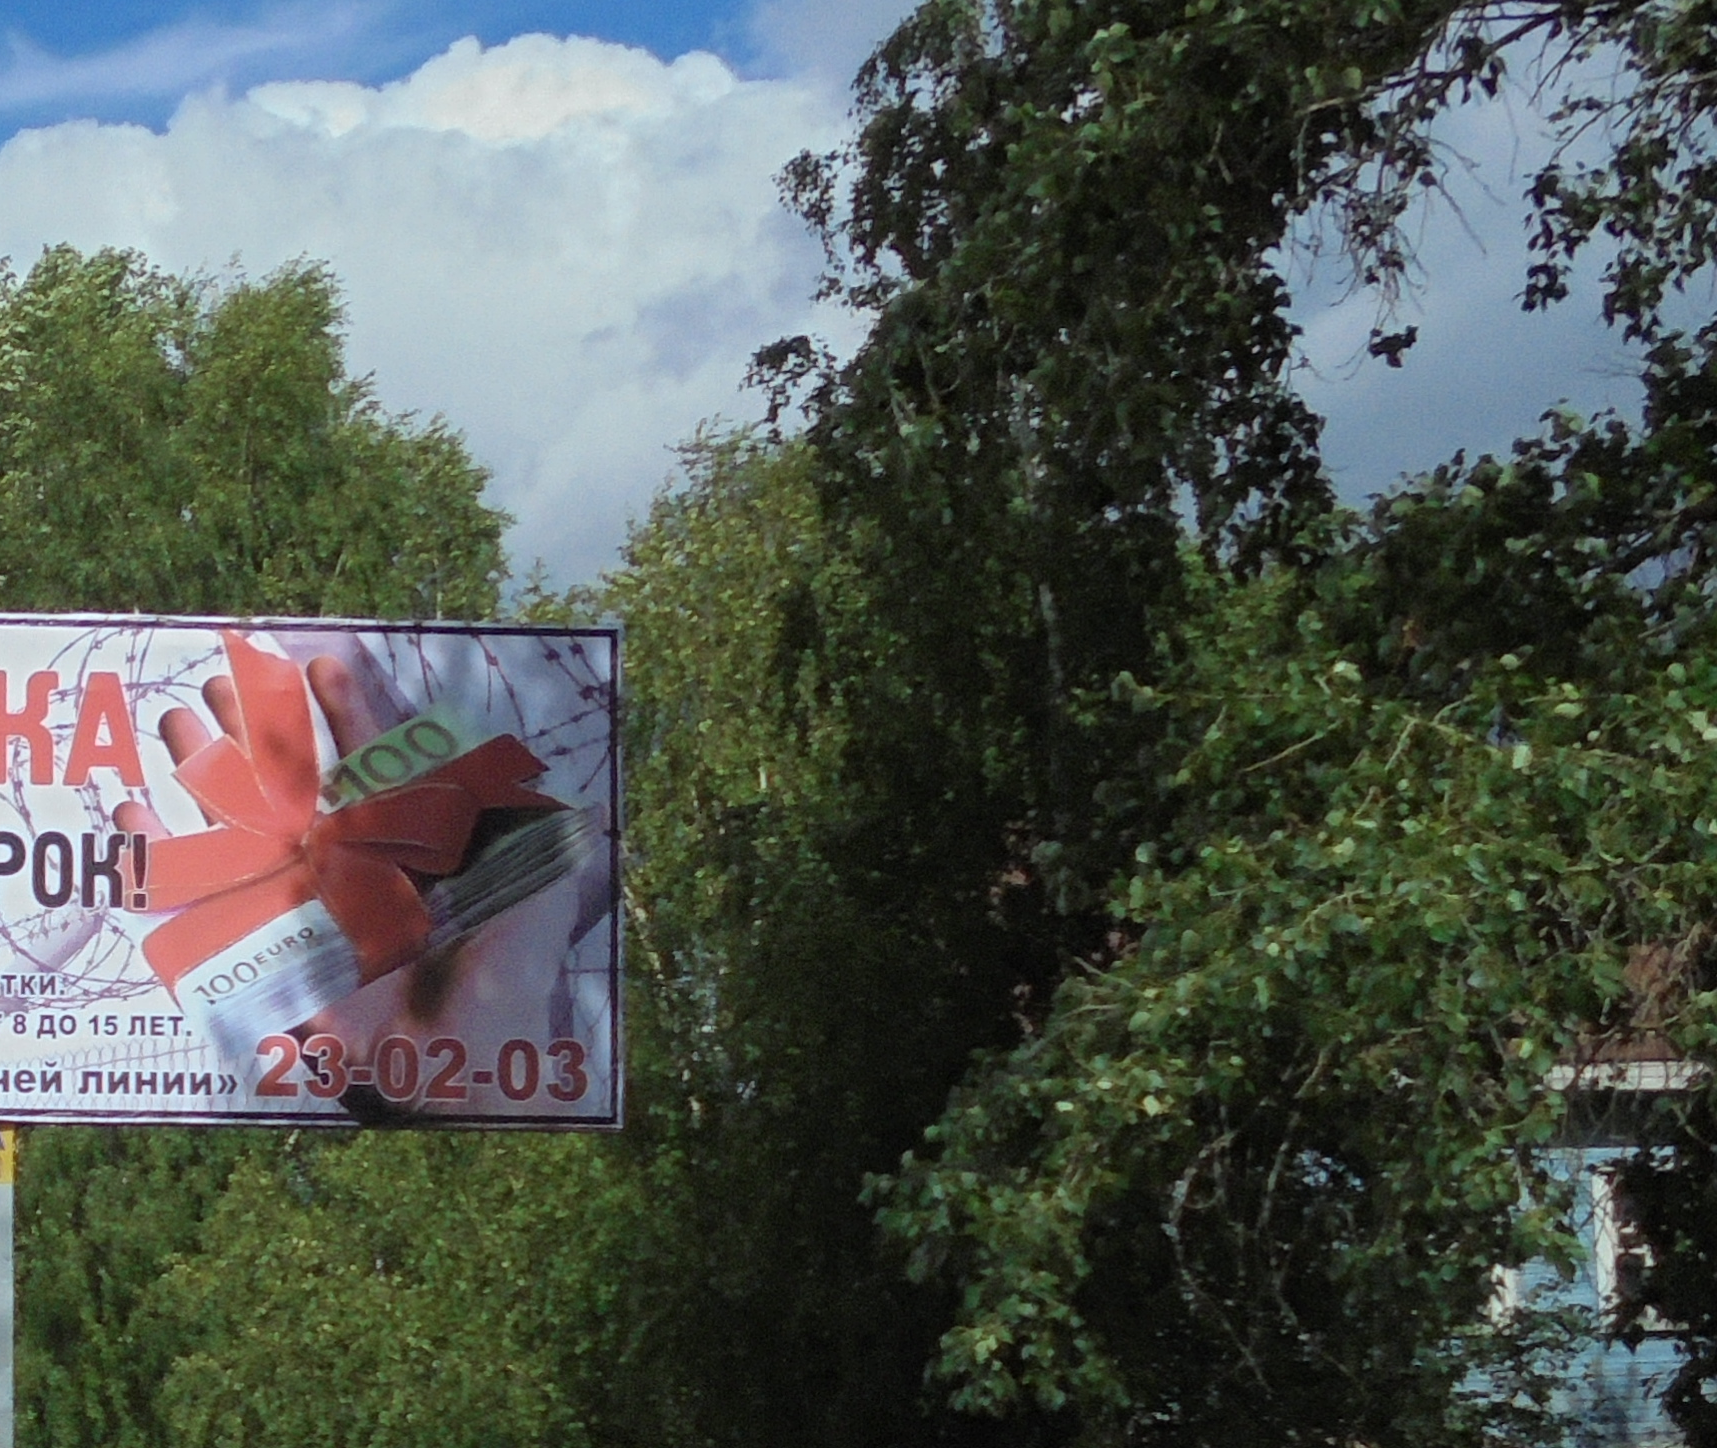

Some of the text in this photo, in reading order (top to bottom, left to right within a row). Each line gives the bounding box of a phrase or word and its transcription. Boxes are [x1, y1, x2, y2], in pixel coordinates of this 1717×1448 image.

[12, 1012, 27, 1036] 8
[36, 1013, 77, 1039] ДО
[89, 1014, 117, 1036] 15
[127, 1014, 193, 1039] ЛЕТ.
[255, 1034, 588, 1101] 23-02-03
[78, 1071, 239, 1097] линии»
